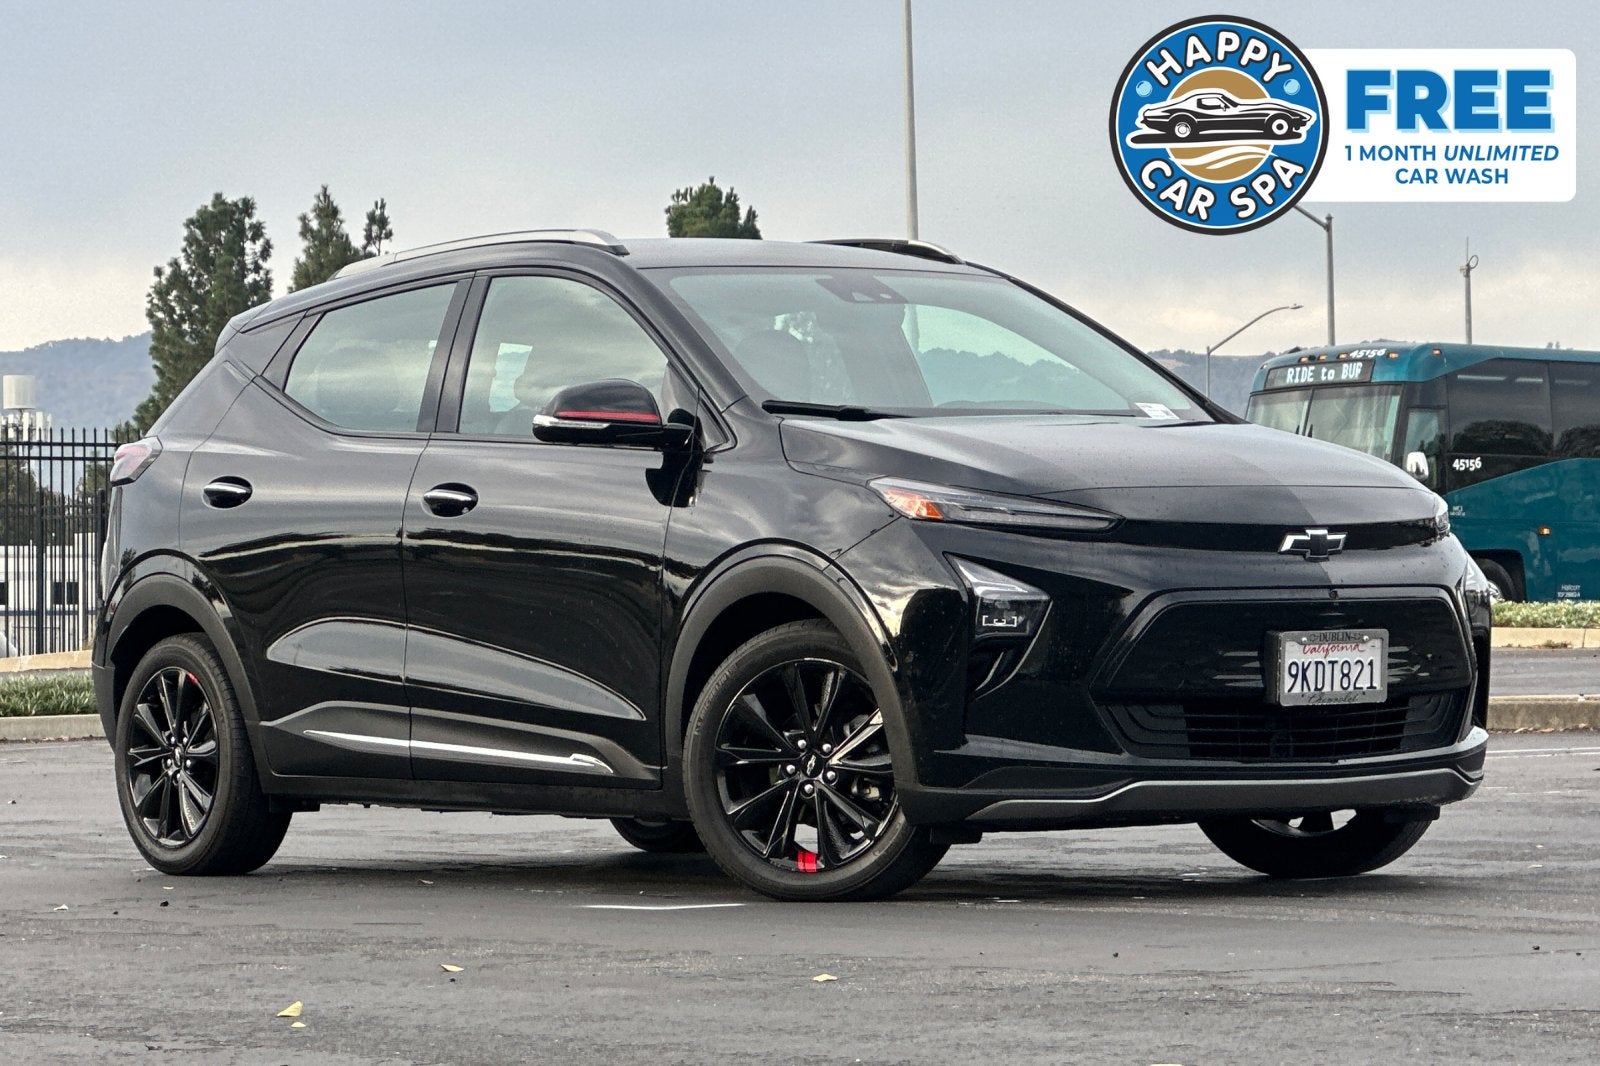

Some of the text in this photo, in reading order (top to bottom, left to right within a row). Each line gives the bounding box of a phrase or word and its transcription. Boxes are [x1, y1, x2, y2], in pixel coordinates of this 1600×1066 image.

[1350, 348, 1387, 359] 45156
[1286, 366, 1315, 384] RIDE
[1321, 367, 1335, 380] to
[1452, 456, 1482, 471] 45156
[1319, 631, 1350, 643] DUBLIN
[1303, 642, 1365, 658] California
[1287, 658, 1377, 693] 9KDT821
